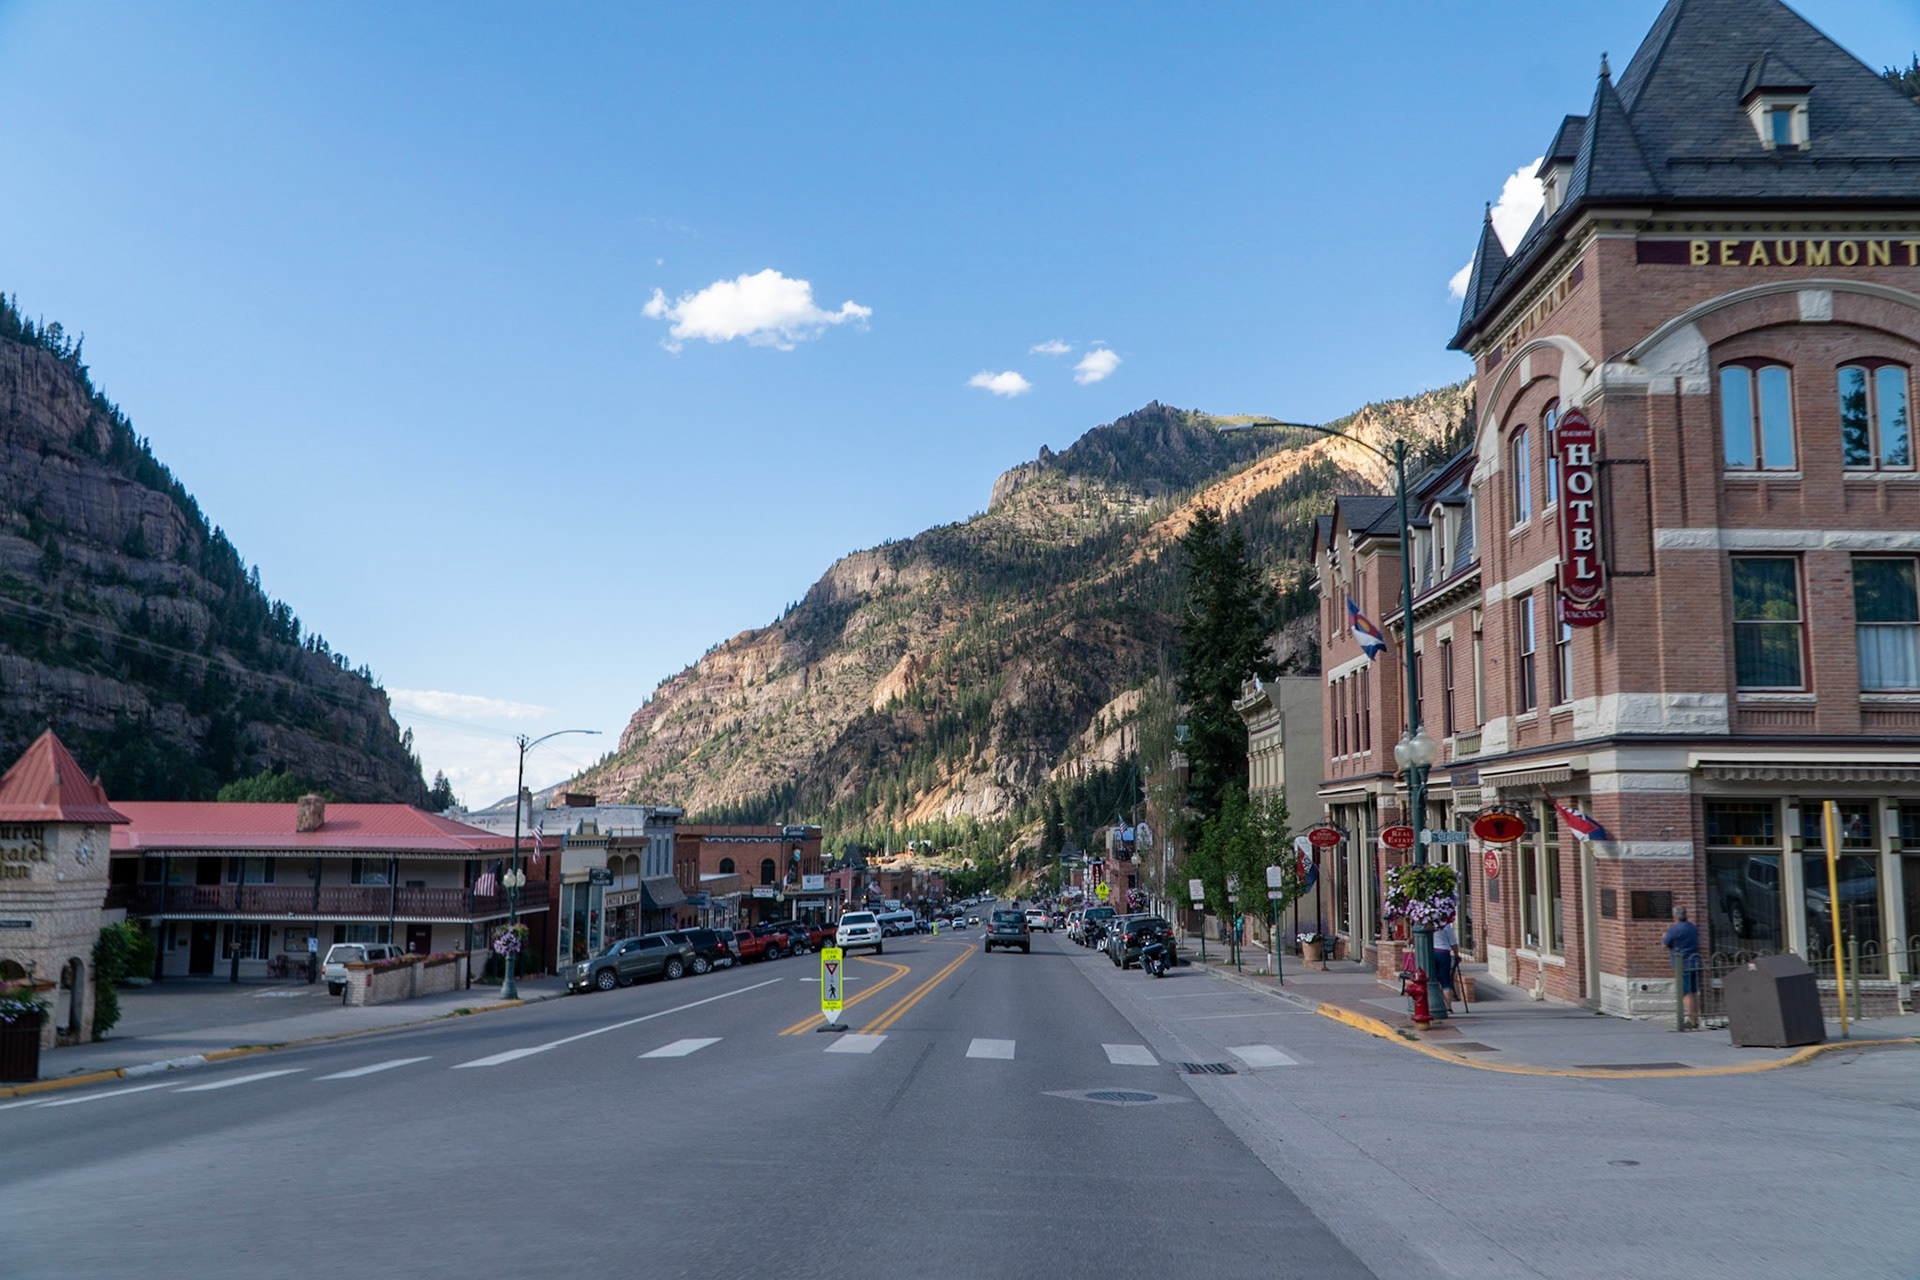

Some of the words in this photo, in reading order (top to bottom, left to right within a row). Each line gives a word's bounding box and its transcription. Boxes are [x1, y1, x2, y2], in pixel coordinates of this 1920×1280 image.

[1689, 240, 1920, 266] BEAUMONT
[1501, 273, 1573, 360] BEAUMONT
[1564, 443, 1596, 579] HOTEL
[1565, 610, 1605, 619] VACANCY
[0, 826, 44, 847] uray
[1391, 829, 1411, 837] REAL
[1484, 858, 1497, 869] SPA
